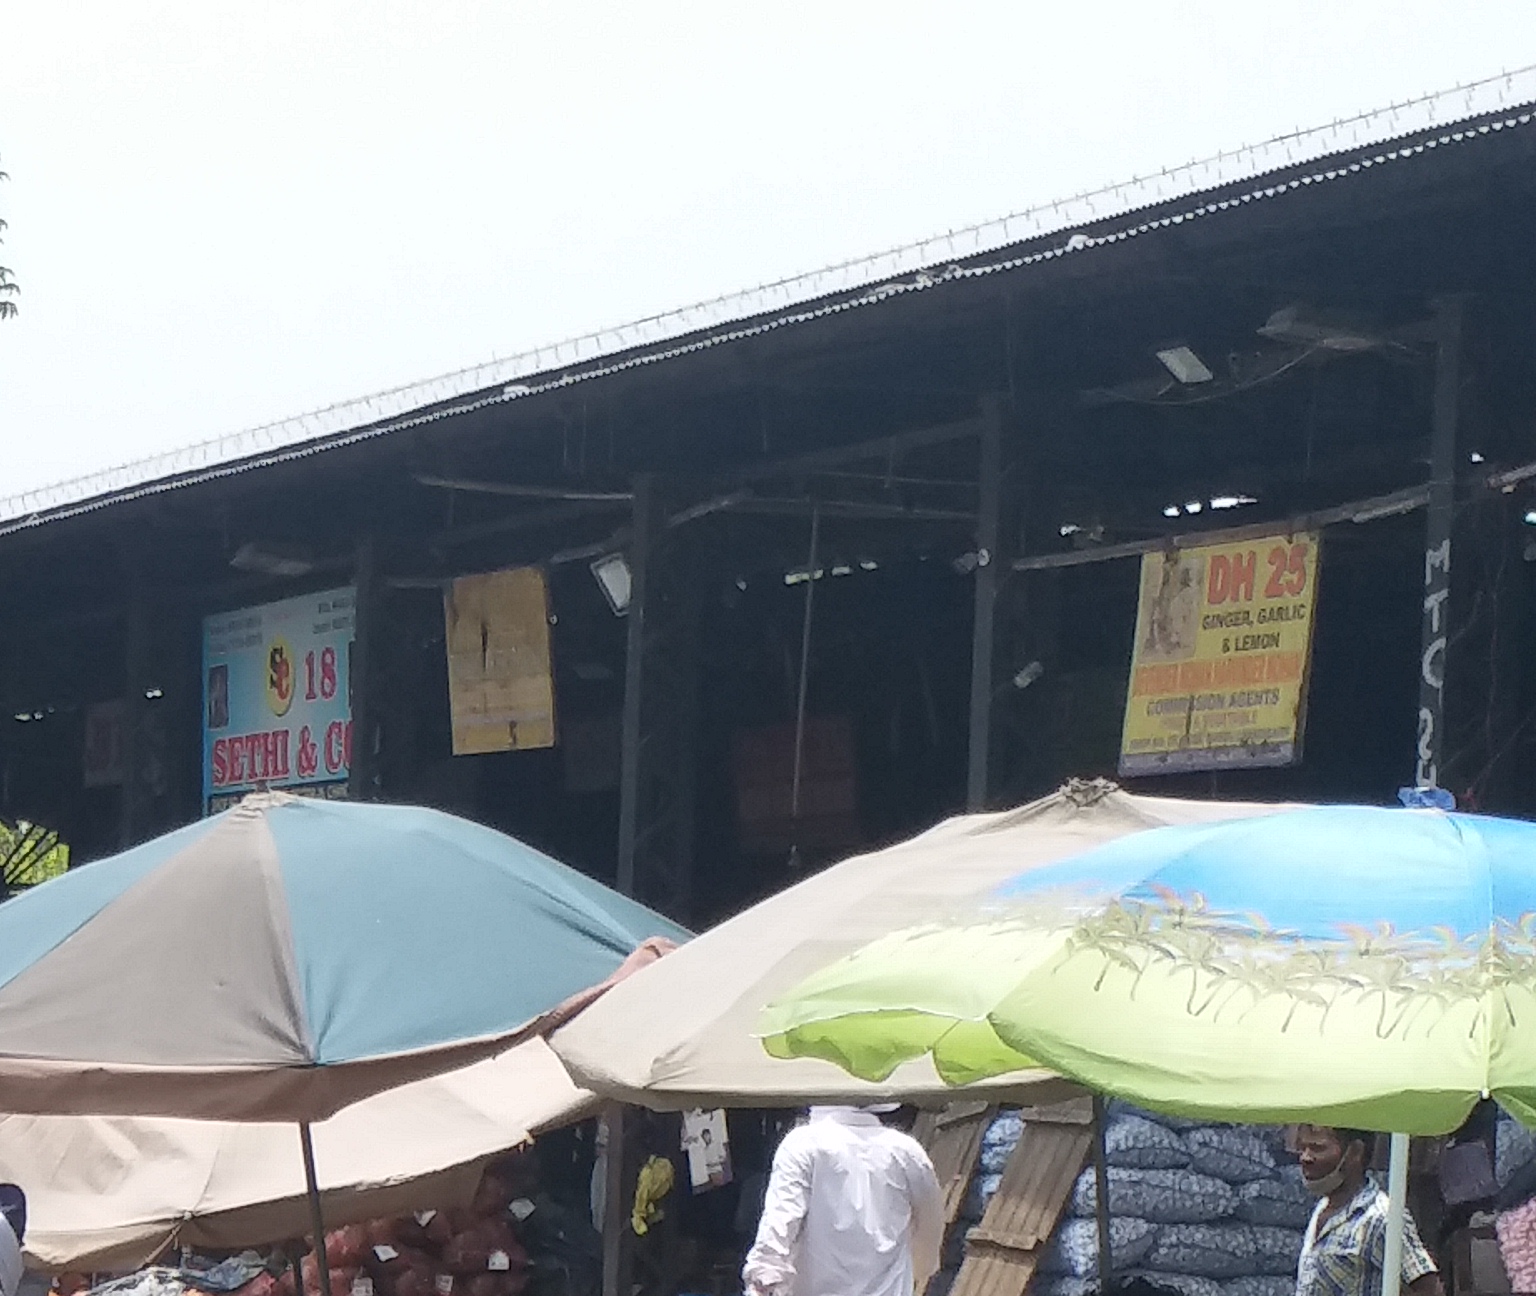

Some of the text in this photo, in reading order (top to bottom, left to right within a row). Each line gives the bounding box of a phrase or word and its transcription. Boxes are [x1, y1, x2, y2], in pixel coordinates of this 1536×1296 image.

[1207, 543, 1308, 605] DH 25
[1202, 604, 1307, 631] GINGER, GARLIC
[1235, 632, 1280, 652] LEMON
[304, 646, 337, 701] 18
[1228, 688, 1280, 708] AGENTS
[212, 729, 289, 785] SETHI
[298, 725, 318, 777] &
